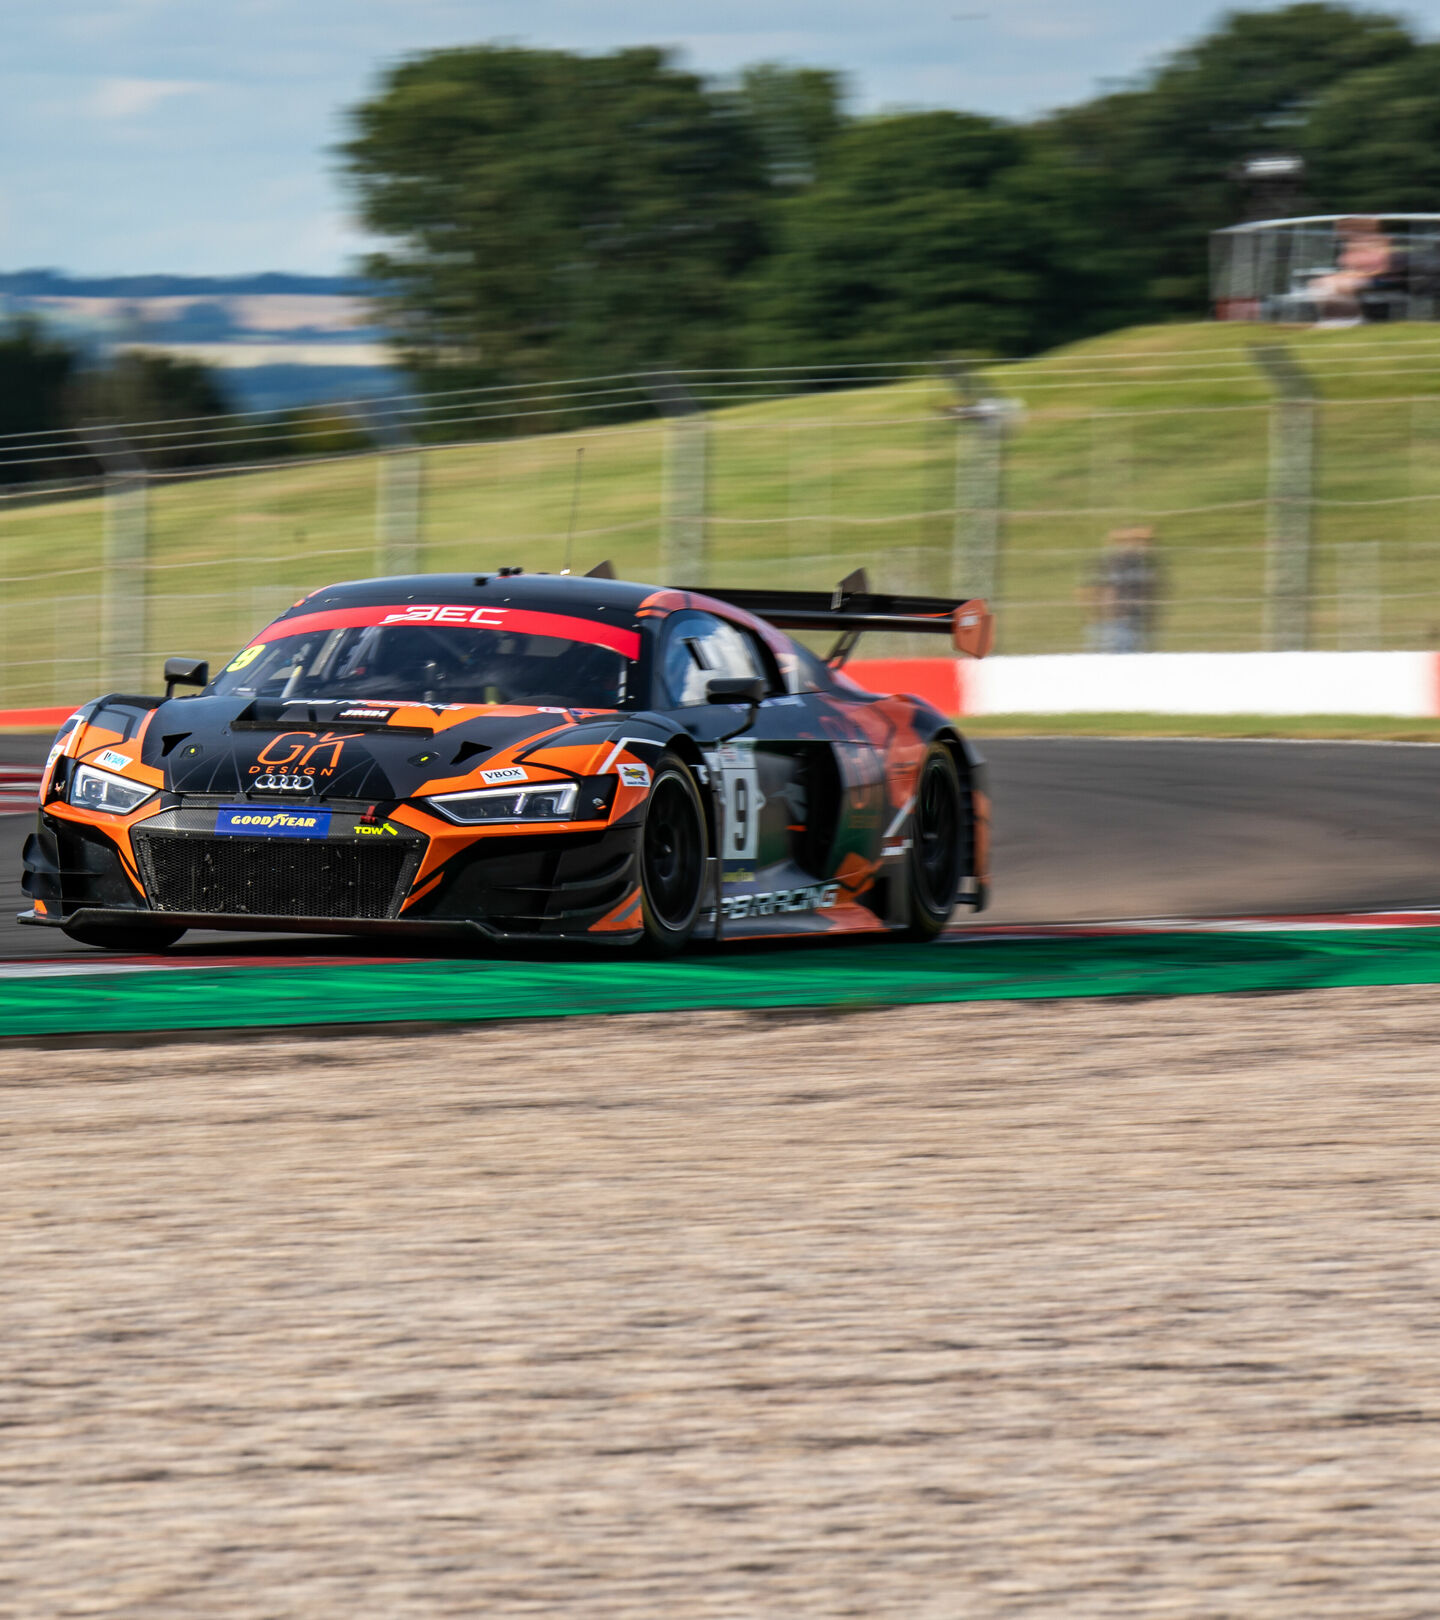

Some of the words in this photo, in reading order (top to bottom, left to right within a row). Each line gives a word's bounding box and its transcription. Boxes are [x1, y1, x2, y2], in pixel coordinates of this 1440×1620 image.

[226, 644, 267, 673] 9
[248, 766, 334, 776] DESIGN
[484, 768, 522, 779] VBOX
[230, 813, 317, 828] GOODYEAR
[734, 778, 748, 851] 9
[353, 826, 384, 835] TOW
